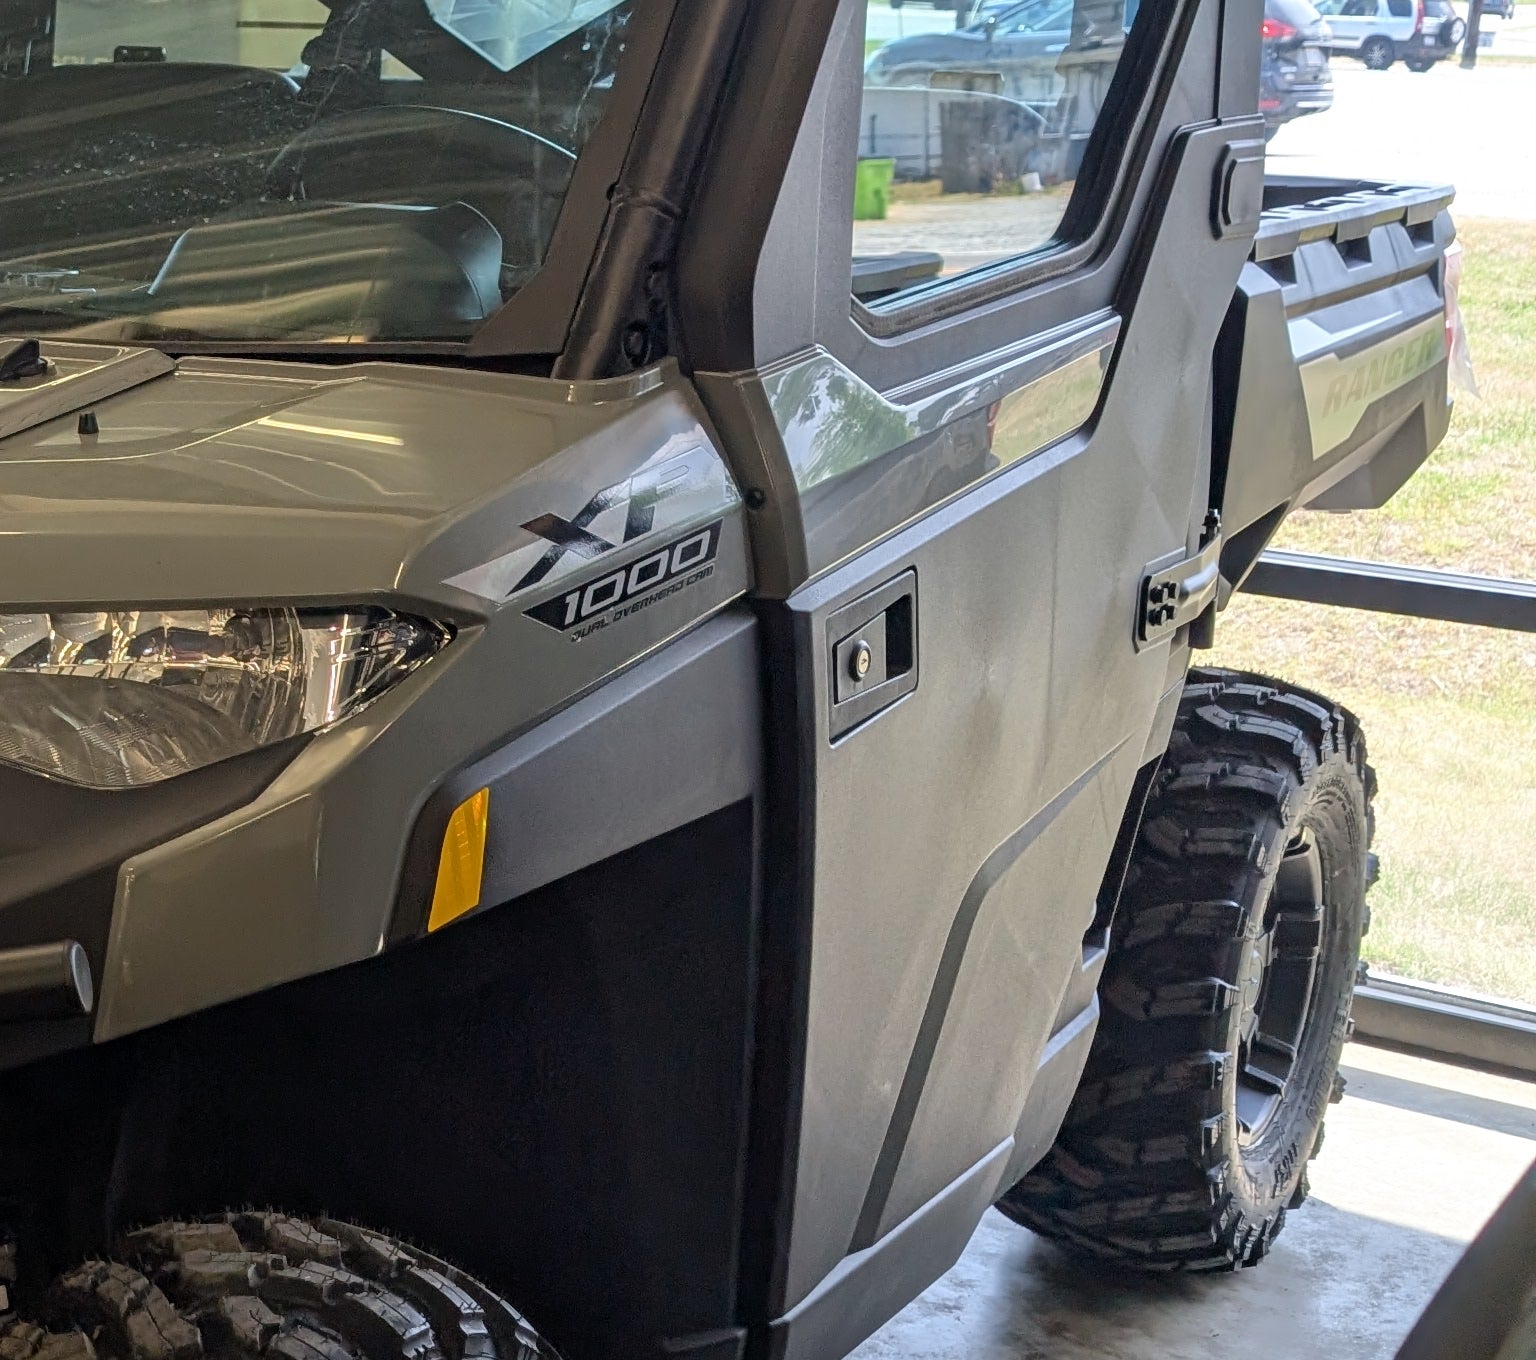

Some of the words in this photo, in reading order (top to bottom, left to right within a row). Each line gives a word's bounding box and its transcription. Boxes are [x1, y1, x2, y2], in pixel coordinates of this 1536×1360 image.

[1322, 327, 1438, 418] RANGER
[564, 529, 712, 626] 1000
[571, 616, 610, 642] DUAL
[612, 581, 684, 622] OVERHEAD
[686, 565, 714, 586] CAM
